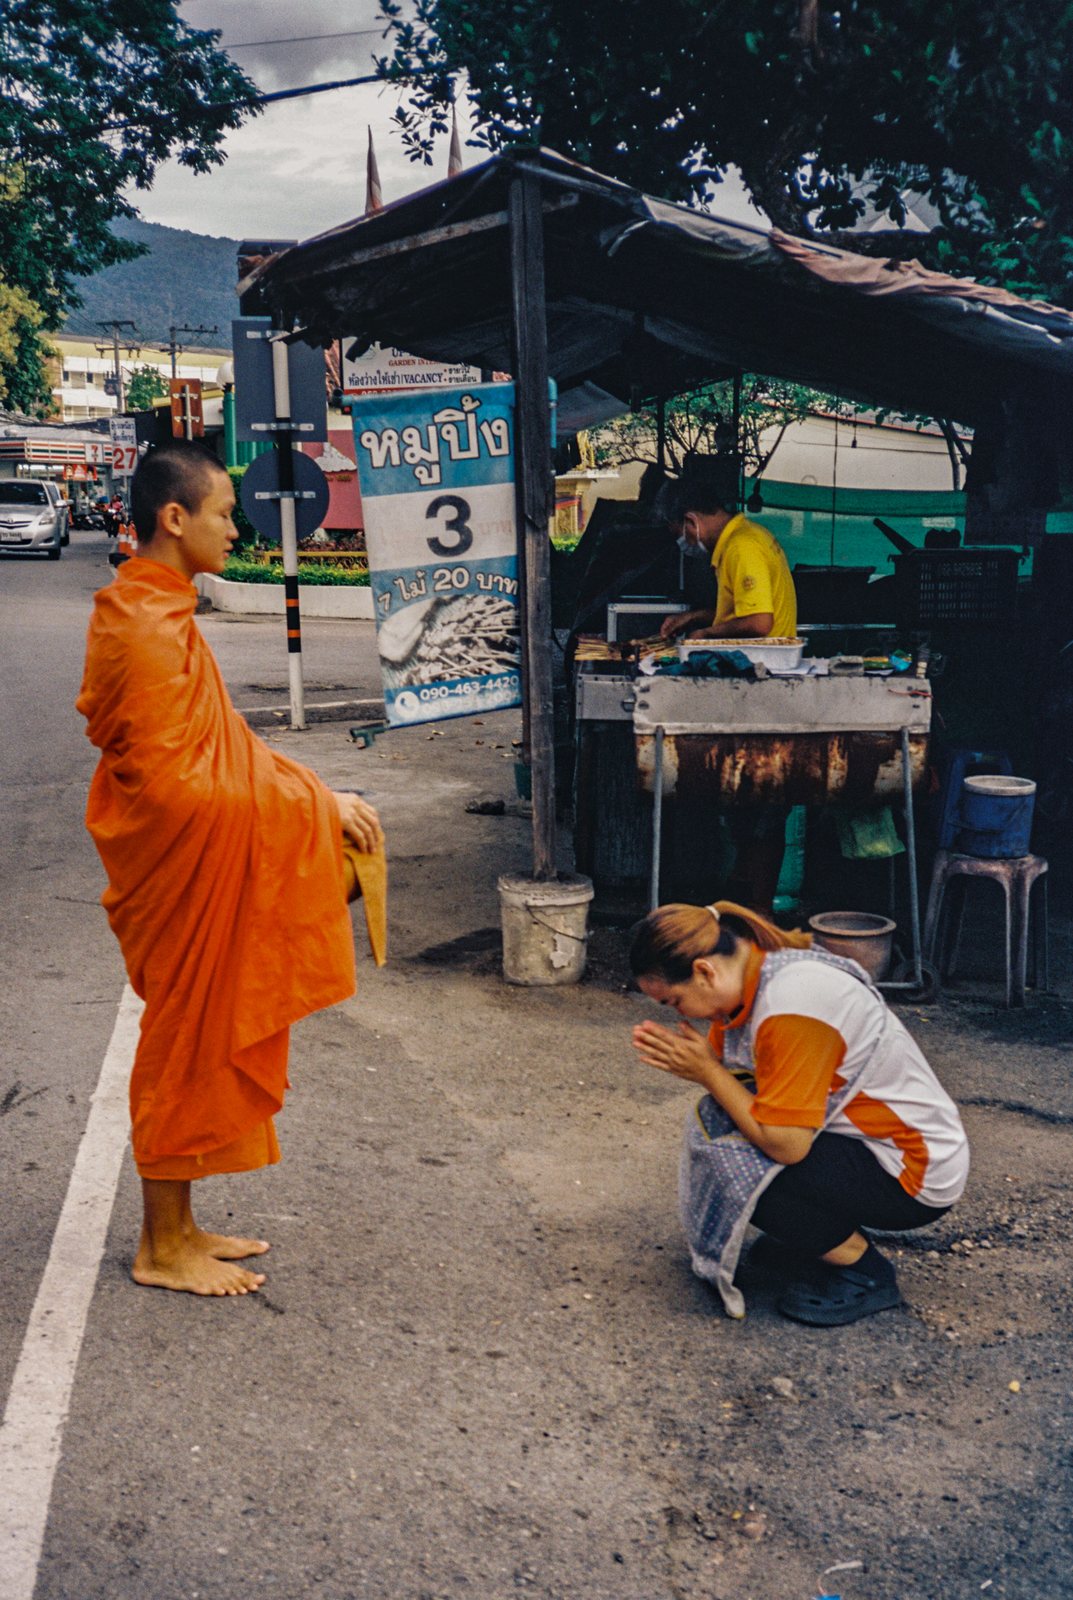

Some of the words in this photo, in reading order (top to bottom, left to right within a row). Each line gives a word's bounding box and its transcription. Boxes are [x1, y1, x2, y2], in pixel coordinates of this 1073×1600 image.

[388, 359, 416, 367] GARDEN
[360, 393, 511, 486] หมูปิ้ง
[113, 448, 137, 469] 27
[426, 495, 474, 557] 3
[393, 568, 428, 602] ไม้
[432, 566, 470, 592] 20
[475, 572, 519, 596] บาท
